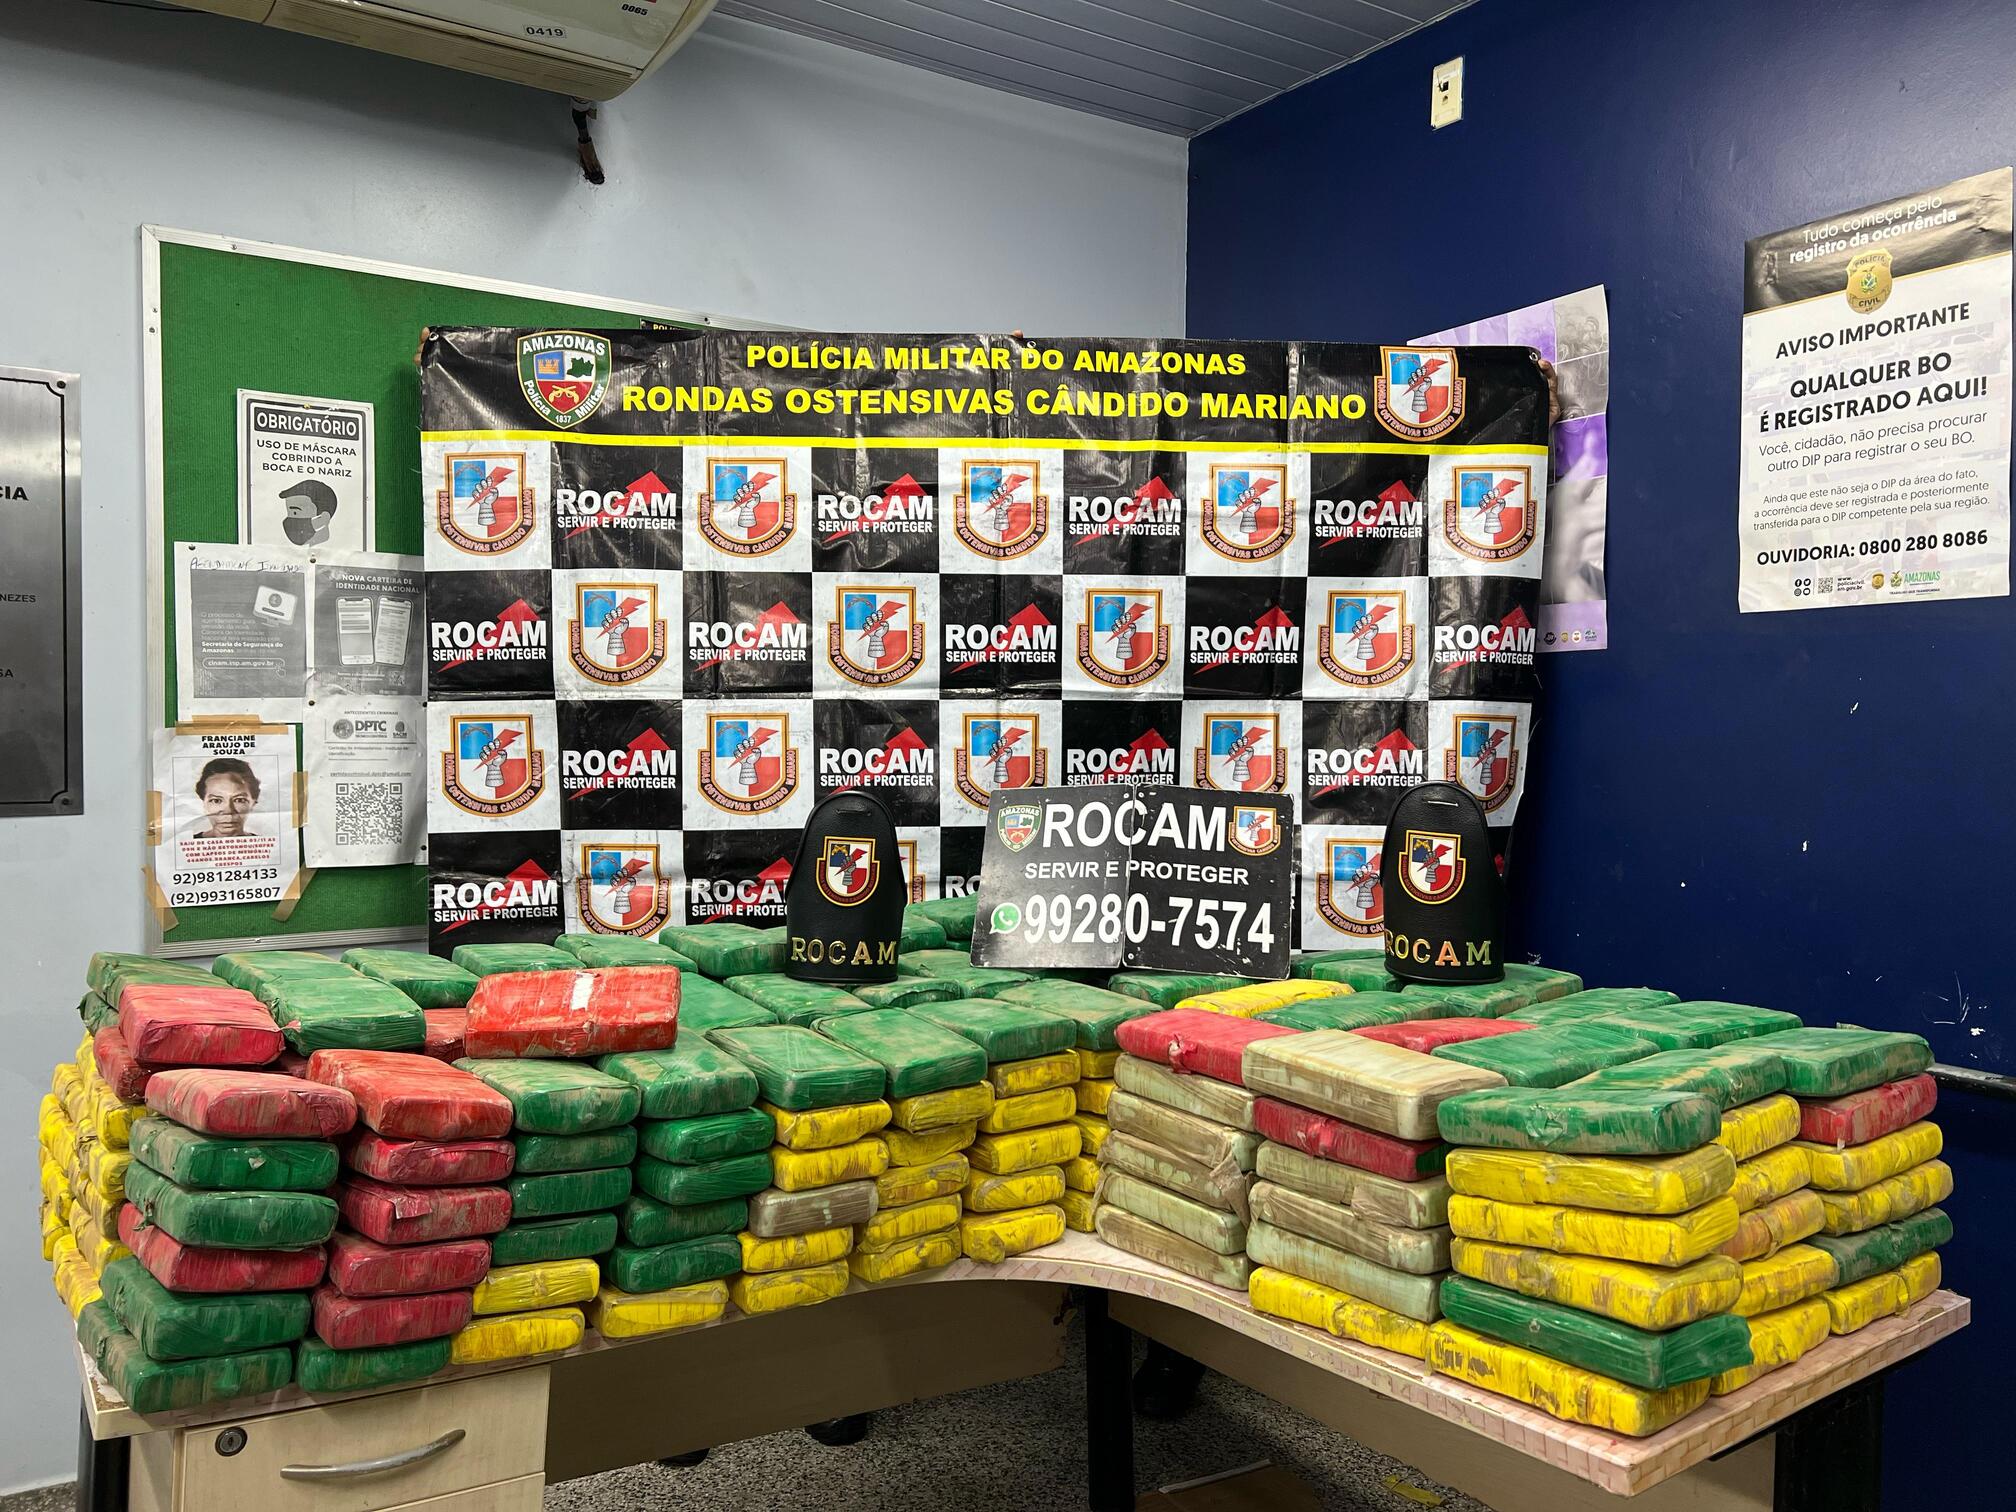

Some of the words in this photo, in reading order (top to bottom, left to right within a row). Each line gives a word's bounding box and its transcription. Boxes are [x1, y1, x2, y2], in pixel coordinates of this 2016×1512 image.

[622, 4, 648, 15] 0065
[526, 27, 563, 36] 0419
[1803, 224, 1838, 243] Tudo
[1843, 210, 1902, 232] começa
[1908, 196, 1942, 215] pelo
[1789, 240, 1846, 263] registro
[1850, 232, 1869, 246] da
[1872, 208, 1957, 240] ocorrência
[1859, 298, 1880, 306] CIVIL
[1776, 333, 1834, 359] AVISO
[1840, 301, 1969, 345] IMPORTANTE
[522, 335, 605, 356] AMAZONAS
[747, 341, 875, 368] POLÍCIA
[884, 347, 1010, 369] MILITAR
[1021, 348, 1063, 370] DO
[1074, 350, 1245, 375] AMAZONAS
[1791, 360, 1911, 398] QUALQUER
[1918, 353, 1951, 375] BO
[574, 384, 604, 418] Militar
[623, 386, 773, 413] RONDAS
[786, 389, 1014, 415] OSTENSIVAS
[1027, 384, 1188, 417] CÂNDIDO
[1202, 393, 1366, 419] MARIANO
[1761, 411, 1768, 432] É
[1775, 390, 1910, 430] REGISTRADO
[1917, 376, 1986, 406] AQUI!
[256, 412, 356, 436] OBRIGATÓRIO
[1759, 442, 1790, 456] Você,
[1795, 434, 1846, 450] cidadão,
[1851, 430, 1874, 442] não
[1878, 422, 1924, 440] precisa
[1929, 412, 1987, 432] procurar
[257, 440, 280, 449] USO
[285, 442, 299, 450] DE
[303, 443, 356, 456] MÁSCARA
[272, 453, 332, 464] COBRINDO
[1768, 460, 1798, 472] outro
[1802, 454, 1820, 466] DIP
[1824, 452, 1850, 466] para
[1856, 444, 1906, 460] registrar
[1924, 438, 1946, 449] seu
[1952, 432, 1974, 445] BO.
[263, 463, 294, 472] BOCA
[319, 468, 351, 477] NARIZ
[1763, 494, 1787, 504] Ainda
[1810, 490, 1828, 498] este
[1831, 486, 1848, 495] não
[1851, 484, 1868, 493] seja
[1881, 479, 1896, 488] DIP
[1914, 476, 1935, 484] área
[1956, 470, 1978, 479] fato,
[557, 489, 676, 516] ROCAM
[818, 494, 933, 520] ROCAM
[1069, 496, 1181, 522] ROCAM
[1315, 500, 1423, 525] ROCAM
[1762, 502, 1807, 517] ocorrência
[1810, 502, 1833, 511] deve
[1852, 493, 1898, 507] registrada
[1911, 483, 1989, 501] posteriormente
[558, 515, 598, 528] SERVIR
[602, 517, 609, 527] E
[614, 515, 676, 530] PROTEGER
[1754, 518, 1798, 530] transferida
[1801, 517, 1820, 526] para
[1832, 512, 1846, 521] DIP
[1849, 506, 1907, 520] competente
[1910, 502, 1931, 514] pela
[1935, 502, 1951, 510] sua
[1955, 496, 1990, 508] região.
[818, 521, 859, 532] SERVIR
[863, 522, 869, 532] E
[872, 522, 932, 532] PROTEGER
[1070, 524, 1109, 534] SERVIR
[1113, 524, 1119, 534] E
[1123, 524, 1180, 537] PROTEGER
[1316, 526, 1353, 537] SERVIR
[1357, 527, 1362, 537] E
[1366, 527, 1422, 538] PROTEGER
[1758, 544, 1854, 565] OUVIDORIA:
[1860, 539, 1900, 555] 0800
[1906, 535, 1937, 551] 280
[1943, 530, 1987, 547] 8086
[367, 576, 402, 584] CARTEIRA
[1904, 571, 1940, 583] AMAZONAS
[432, 620, 546, 648] ROCAM
[690, 622, 806, 648] ROCAM
[946, 624, 1056, 650] ROCAM
[1190, 626, 1299, 651] ROCAM
[1433, 625, 1535, 652] ROCAM
[433, 649, 473, 661] SERVIR
[477, 649, 483, 660] E
[487, 648, 546, 660] PROTEGER
[690, 649, 730, 660] SERVIR
[734, 650, 741, 660] E
[745, 649, 806, 660] PROTEGER
[946, 651, 986, 662] SERVIR
[990, 652, 996, 662] E
[999, 652, 1056, 662] PROTEGER
[1190, 652, 1229, 663] SERVIR
[1233, 653, 1239, 663] E
[1243, 652, 1297, 663] PROTEGER
[1435, 651, 1476, 662] SERVIR
[1480, 652, 1486, 662] E
[1490, 652, 1532, 664] PROTEGER
[355, 720, 386, 731] DPTC
[563, 750, 676, 776] ROCAM
[820, 748, 934, 773] ROCAM
[1067, 748, 1174, 773] ROCAM
[1308, 748, 1422, 774] ROCAM
[564, 777, 604, 788] SERVIR
[608, 778, 614, 788] E
[618, 777, 676, 788] PROTEGER
[821, 775, 860, 786] SERVIR
[864, 776, 870, 786] E
[874, 775, 933, 786] PROTEGER
[1068, 774, 1104, 785] SERVIR
[1108, 774, 1114, 785] E
[1118, 774, 1173, 785] PROTEGER
[1308, 775, 1349, 785] SERVIR
[1353, 775, 1359, 785] E
[1364, 775, 1422, 786] PROTEGER
[1044, 800, 1226, 852] ROCAM
[173, 868, 277, 885] 92)981284133
[1025, 862, 1099, 879] SERVIR
[1106, 862, 1118, 877] E
[1126, 860, 1248, 885] PROTEGER
[171, 887, 280, 905] (92)993165807
[434, 880, 558, 910] ROCAM
[692, 878, 788, 903] ROCA
[435, 910, 479, 922] SERVIR
[483, 909, 490, 919] E
[494, 906, 557, 919] PROTEGER
[692, 904, 733, 916] SERVIR
[736, 905, 743, 915] E
[1024, 893, 1275, 954] 99280-7574
[790, 937, 897, 966] ROCAM
[1385, 928, 1492, 966] ROCAM
